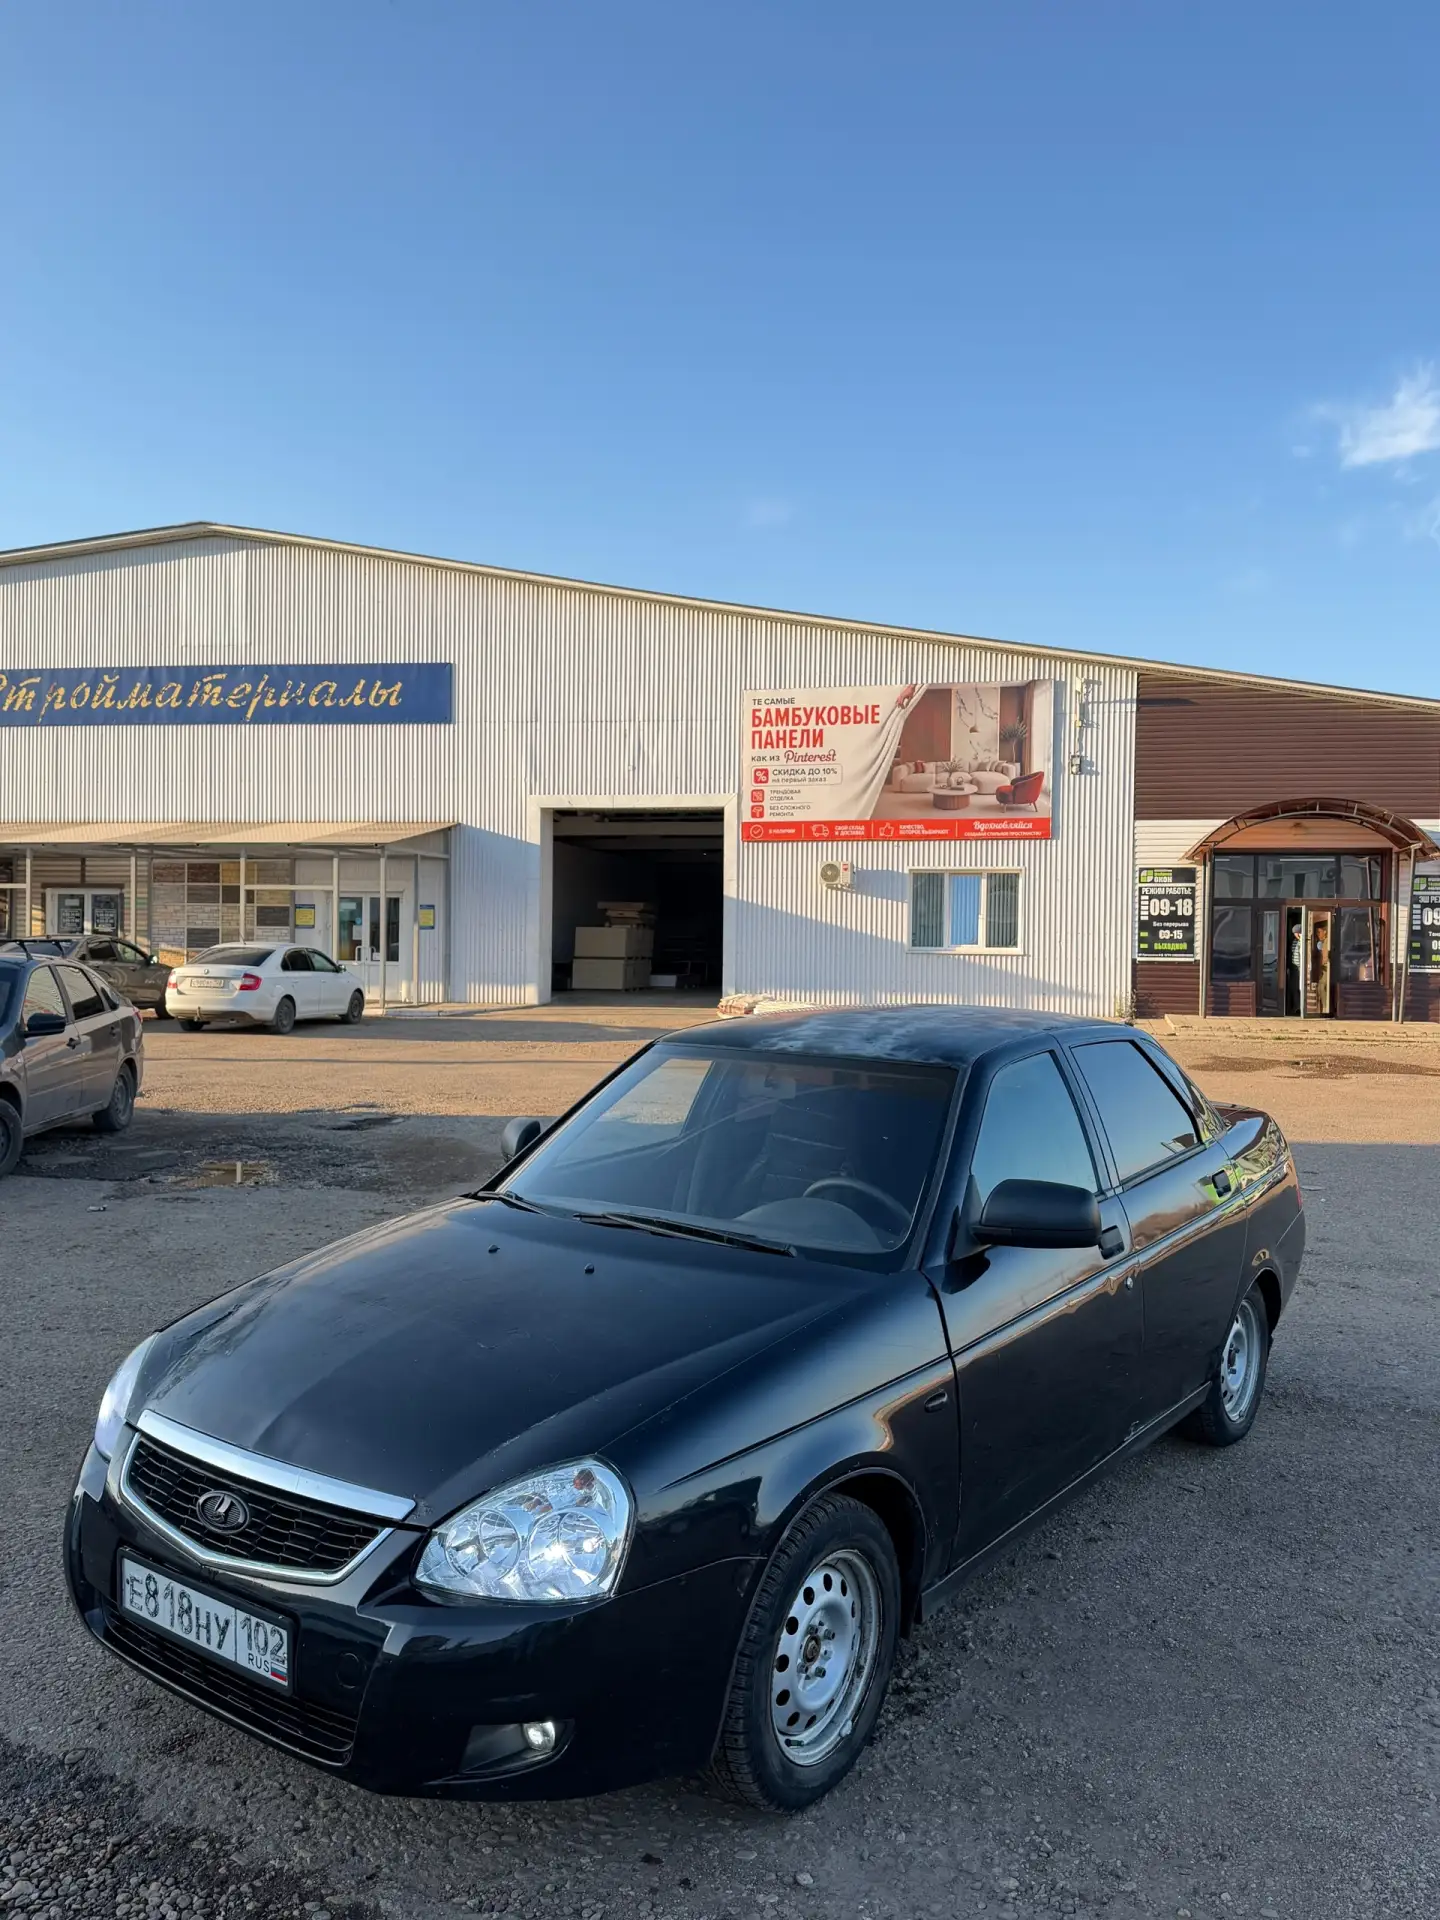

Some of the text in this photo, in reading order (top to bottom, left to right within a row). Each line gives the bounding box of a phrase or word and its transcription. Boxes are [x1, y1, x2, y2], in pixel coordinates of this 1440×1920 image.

[764, 697, 795, 705] САМЫЕ
[751, 705, 880, 728] БАМБУКОВЫЕ
[751, 729, 824, 749] ПАНЕЛИ
[784, 749, 836, 763] Pinterest
[772, 767, 837, 776] СКИДКА ДО 10%
[1142, 887, 1192, 895] РЕЖИМ РАБОТЫ:
[1149, 898, 1193, 916] 09-18
[129, 1573, 287, 1666] Е818НУ 102
[247, 1653, 270, 1673] RUS
